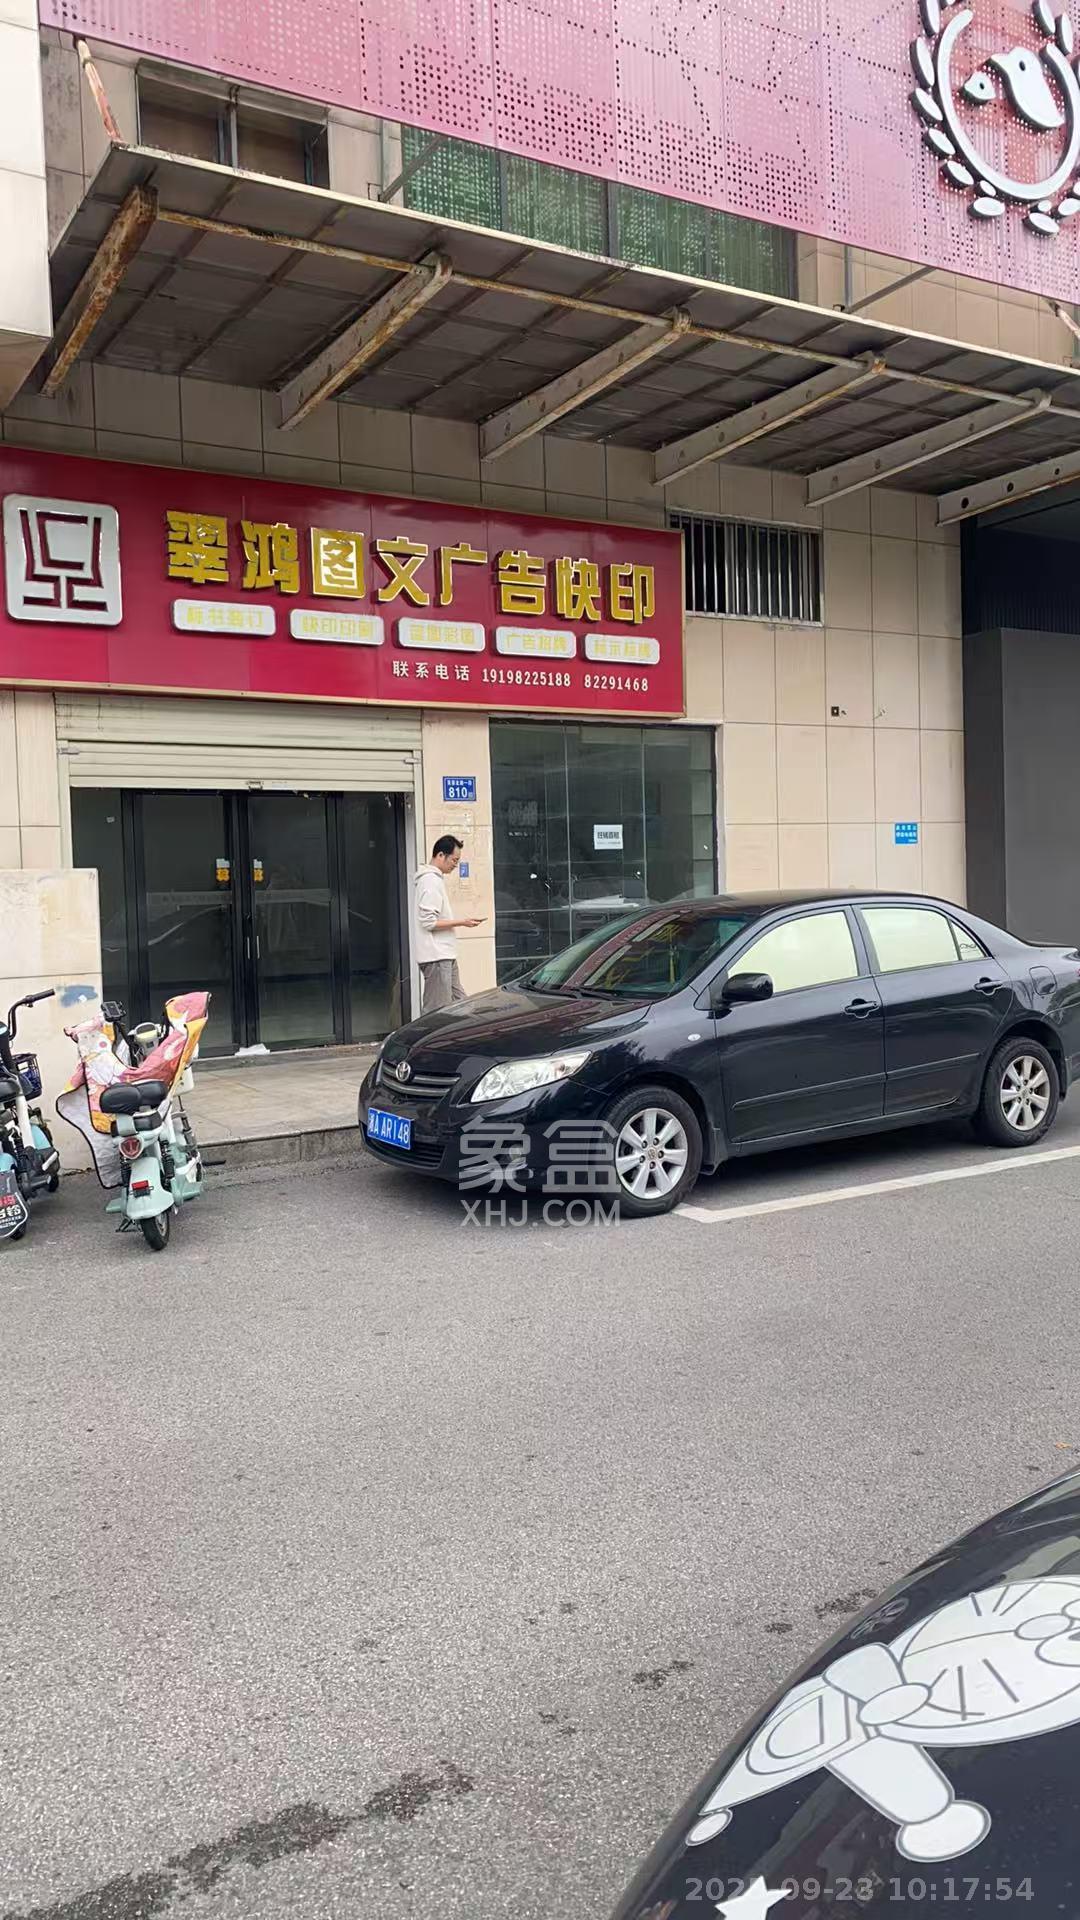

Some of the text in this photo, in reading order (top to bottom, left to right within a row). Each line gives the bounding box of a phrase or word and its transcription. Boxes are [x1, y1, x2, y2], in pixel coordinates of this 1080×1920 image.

[393, 660, 649, 692] 联系电话 19198225188 82291468
